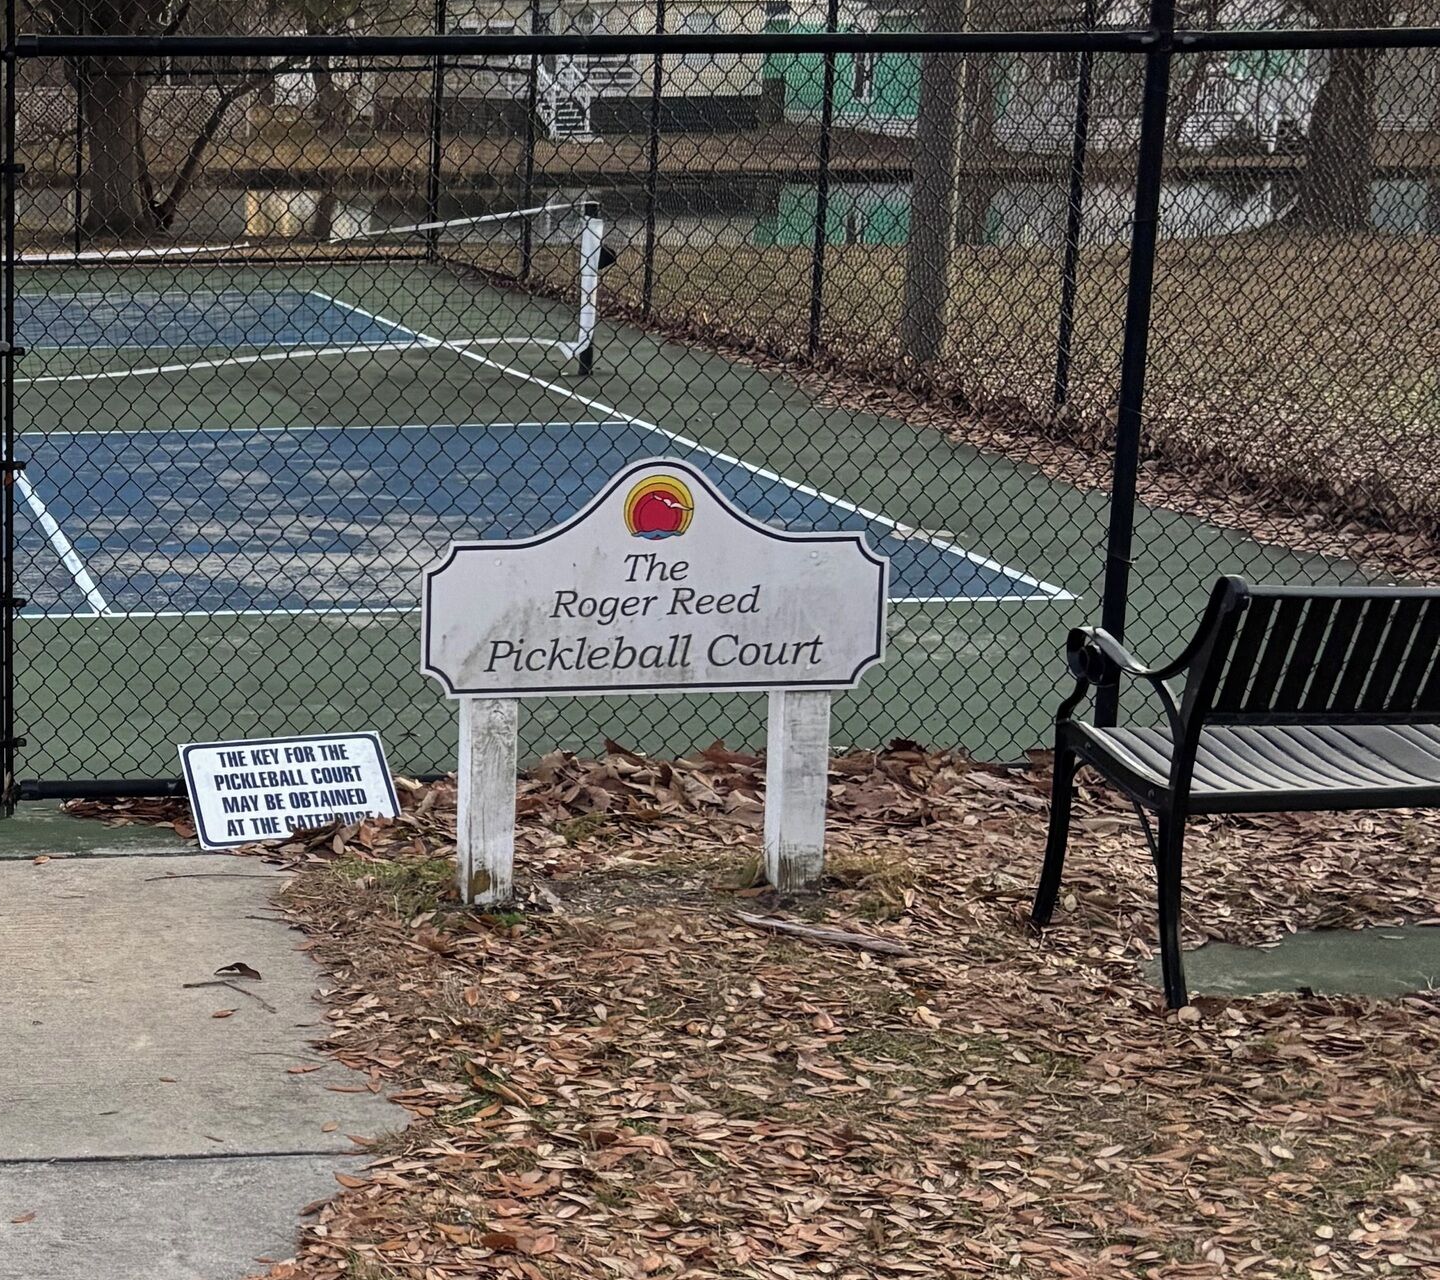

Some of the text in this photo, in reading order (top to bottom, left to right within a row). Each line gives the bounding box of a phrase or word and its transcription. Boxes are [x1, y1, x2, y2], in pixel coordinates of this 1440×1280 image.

[624, 553, 689, 581] The
[549, 585, 760, 625] Roger Reed
[484, 634, 823, 672] Pickleball Court
[217, 744, 349, 767] THE KEY FOR THE
[214, 766, 361, 790] PICKLEBALL COURT
[222, 789, 367, 813] MAY BE OBTAINED
[228, 819, 244, 836] AT
[250, 817, 281, 834] THE
